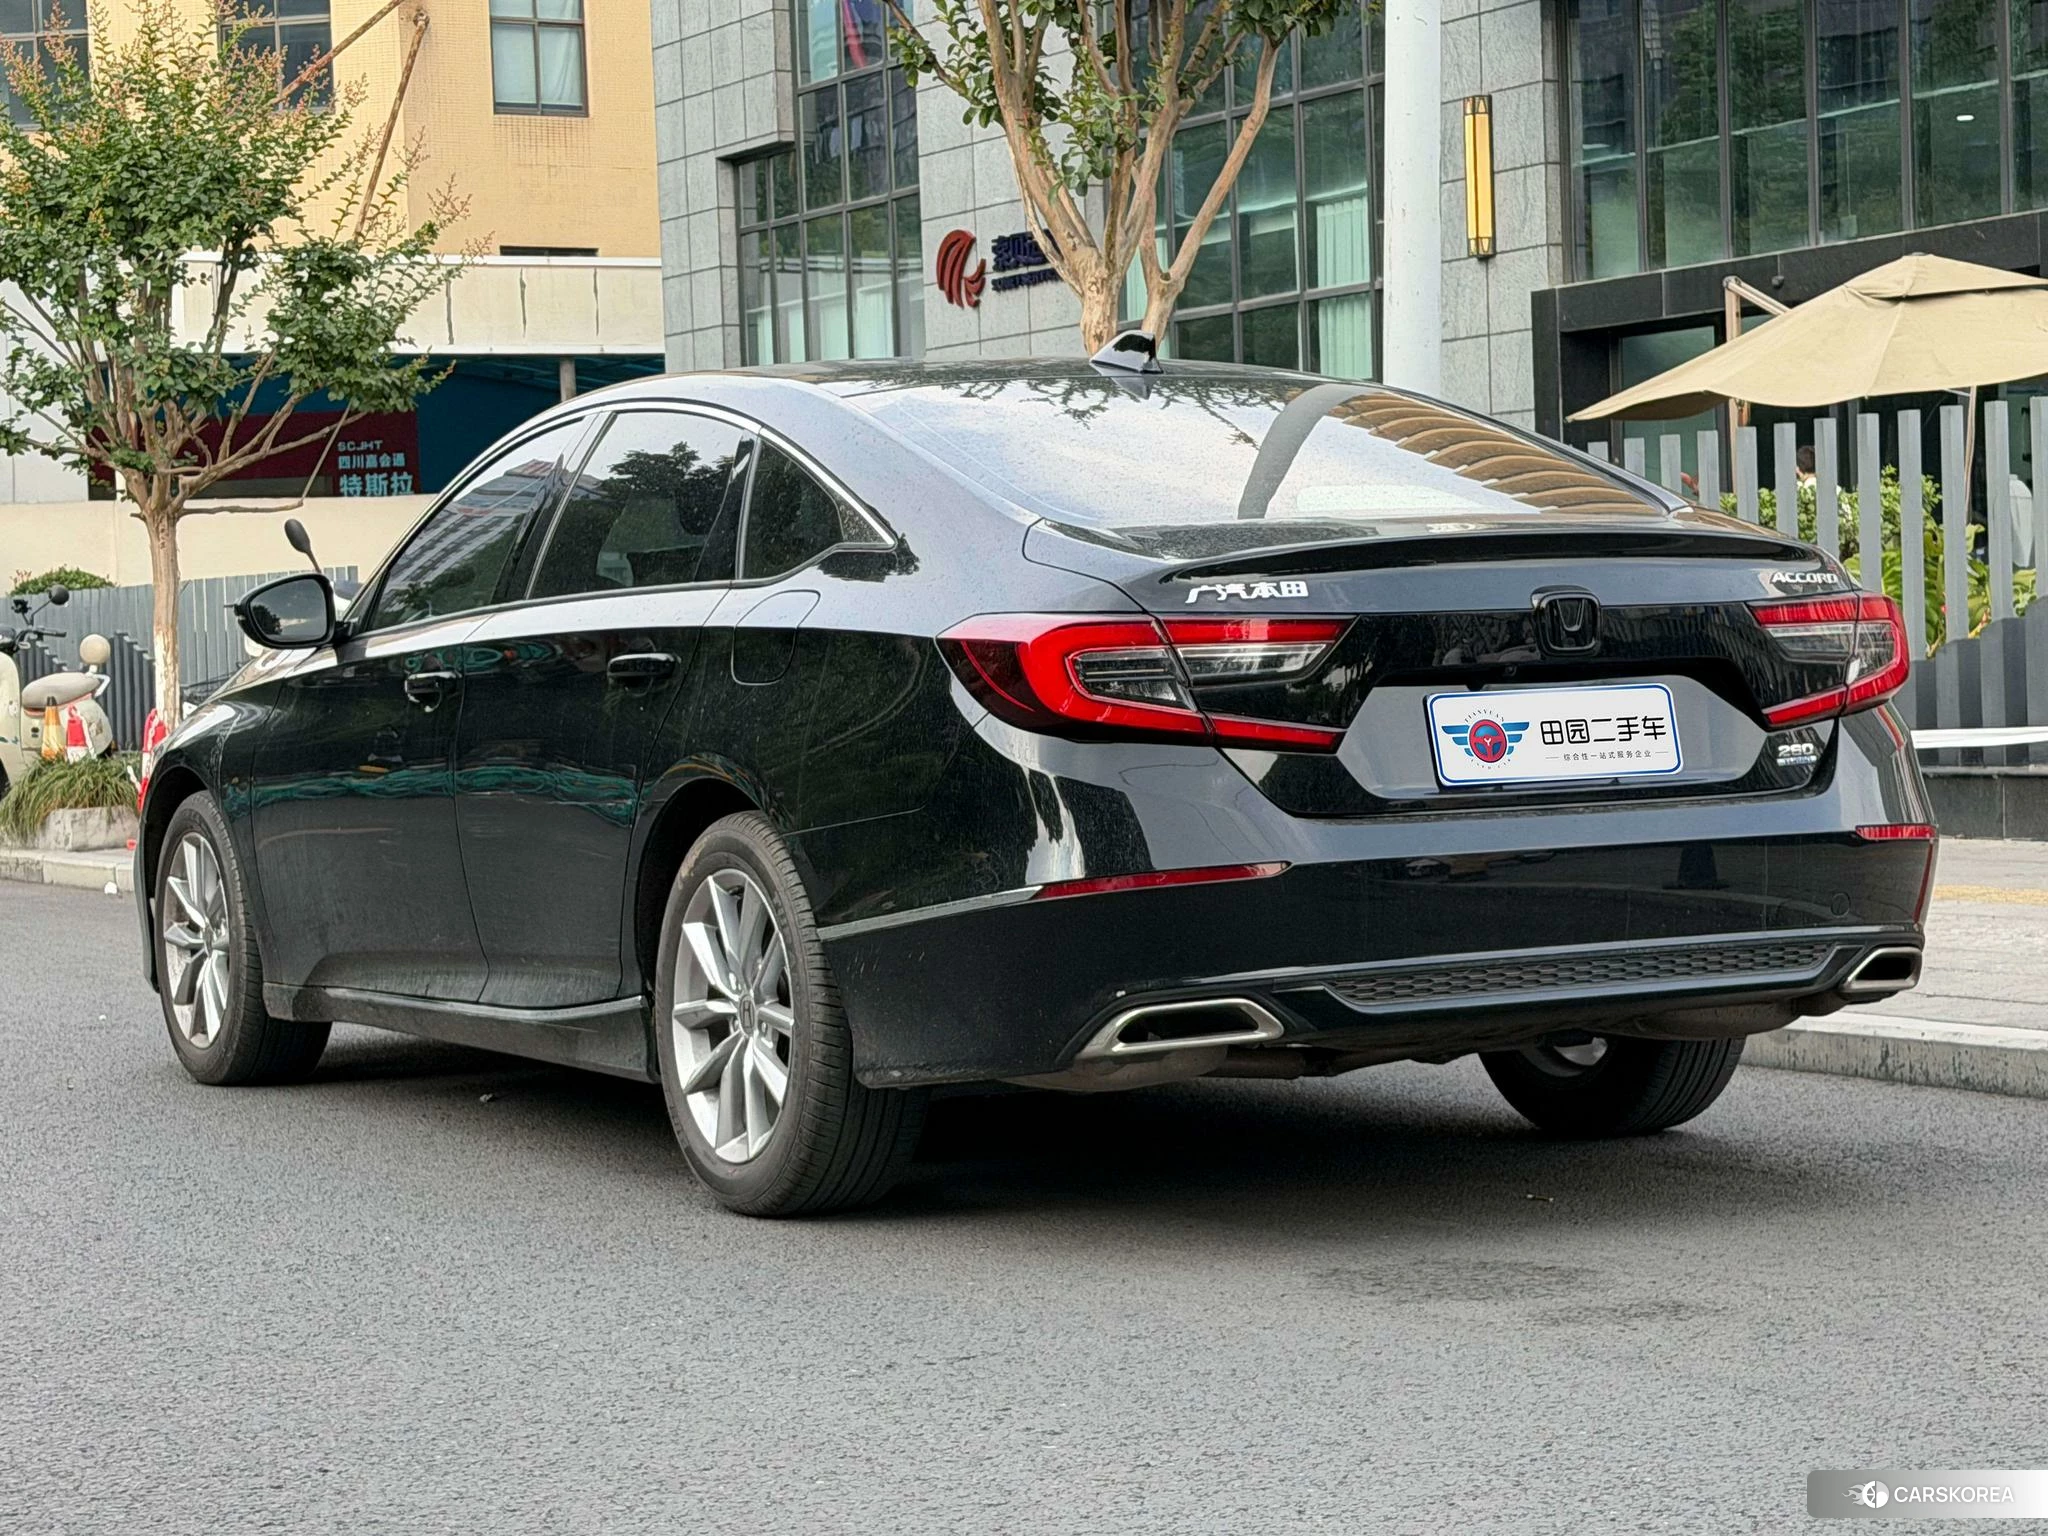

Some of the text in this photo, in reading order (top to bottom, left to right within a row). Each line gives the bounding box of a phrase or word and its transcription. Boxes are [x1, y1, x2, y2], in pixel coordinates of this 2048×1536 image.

[339, 471, 414, 497] 特斯拉
[1772, 571, 1838, 584] ACCORD
[1185, 581, 1309, 604] 广汽本田
[1540, 715, 1667, 746] 田园二手车
[1563, 750, 1652, 762] 综合性一站式服务企业
